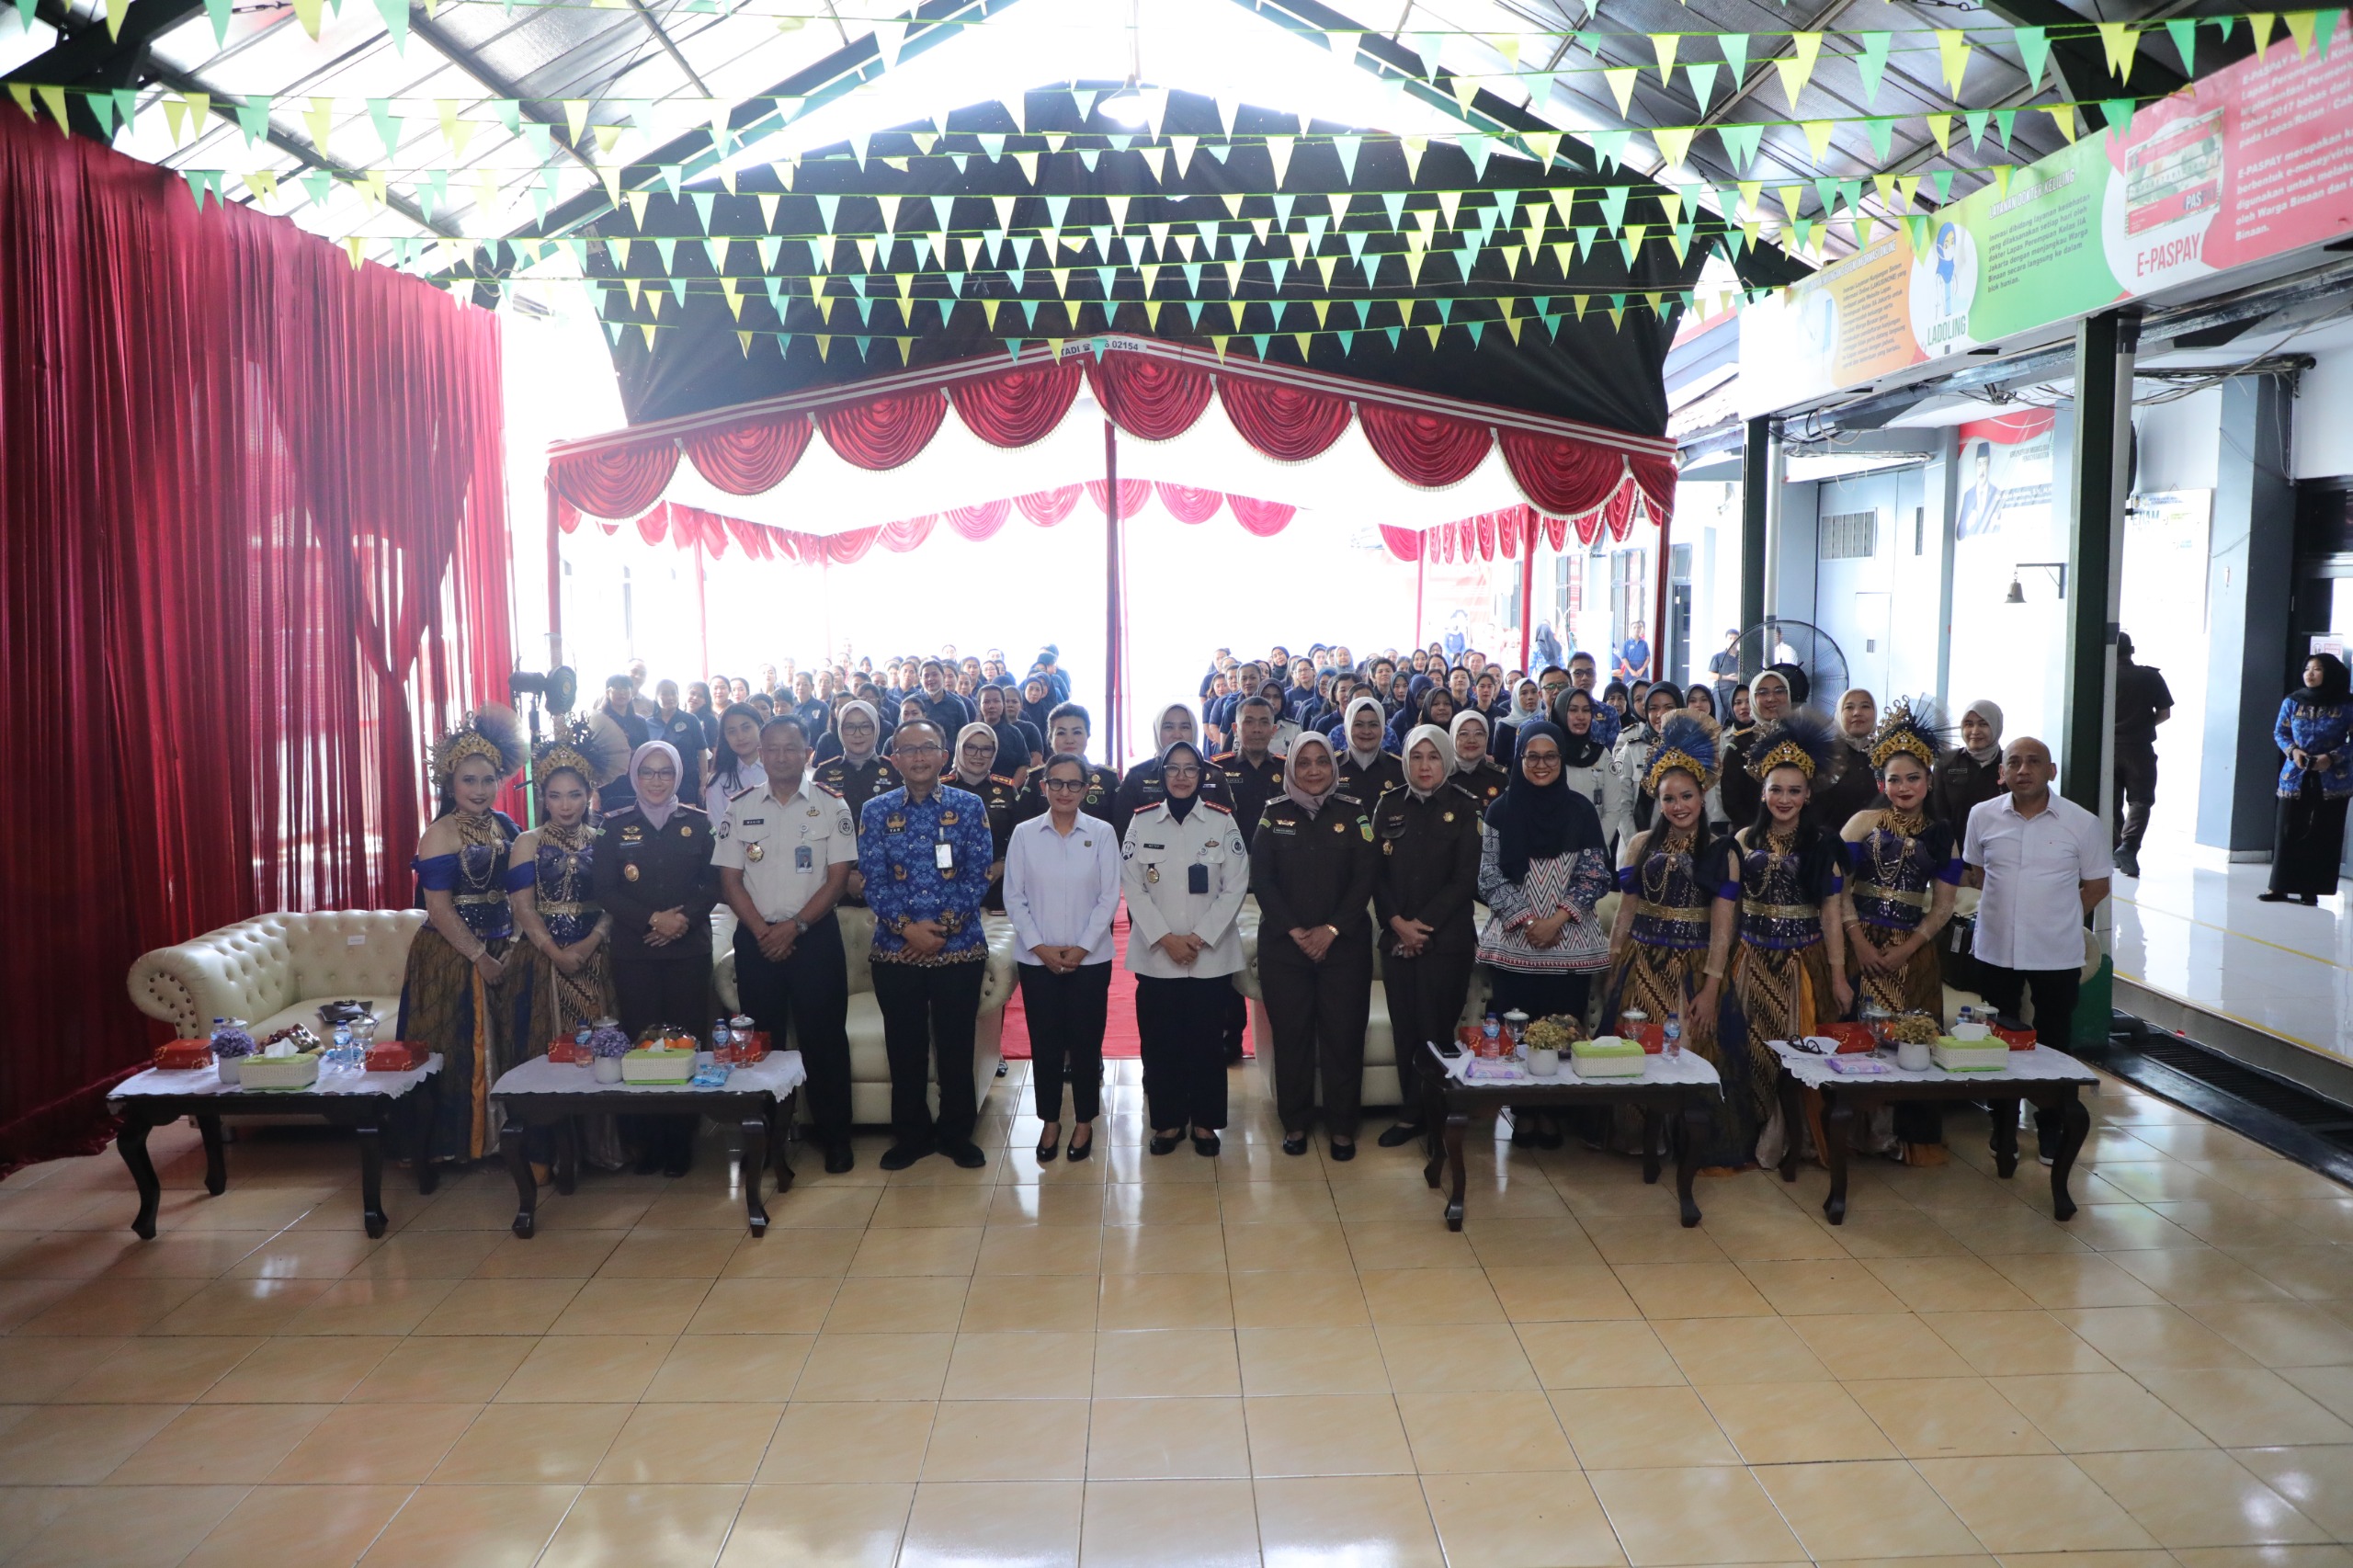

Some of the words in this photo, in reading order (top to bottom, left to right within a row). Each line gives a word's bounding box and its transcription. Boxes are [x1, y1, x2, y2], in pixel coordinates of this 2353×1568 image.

[2271, 101, 2294, 119] 2017
[2238, 153, 2282, 178] E-PASPAY
[2285, 134, 2342, 162] merupakan
[1989, 195, 2016, 220] LAYANAN
[2017, 183, 2042, 208] DOKTER
[2043, 168, 2075, 195] KELILING
[2236, 187, 2284, 210] digunakan
[2287, 175, 2315, 192] untuk
[2237, 170, 2284, 195] berbentuk
[2033, 209, 2057, 223] layanan
[2235, 211, 2256, 225] oleh
[2258, 201, 2288, 218] Warga
[2290, 189, 2325, 207] Binaan
[2327, 181, 2347, 195] dan
[1988, 242, 2001, 253] yang
[2040, 218, 2059, 232] setiap
[2060, 211, 2073, 222] hari
[2074, 206, 2087, 218] oleh
[1988, 249, 2006, 262] dokter
[2006, 242, 2023, 256] Lapas
[2024, 230, 2057, 248] Perempuan
[2059, 222, 2075, 234] Kelas
[1988, 259, 2008, 272] Jakarta
[2009, 251, 2030, 265] dengan
[2031, 236, 2067, 256] menjangkau
[2068, 228, 2088, 242] Warga
[1988, 270, 2006, 282] Binaan
[2007, 263, 2026, 276] secara
[2027, 253, 2053, 267] langsung
[2054, 249, 2063, 257] ke
[2063, 242, 2083, 255] dalam
[2137, 233, 2200, 278] E-PASPAY
[1987, 282, 1999, 293] blok
[1112, 340, 1139, 351] 02154
[1927, 315, 1966, 347] LADOLING
